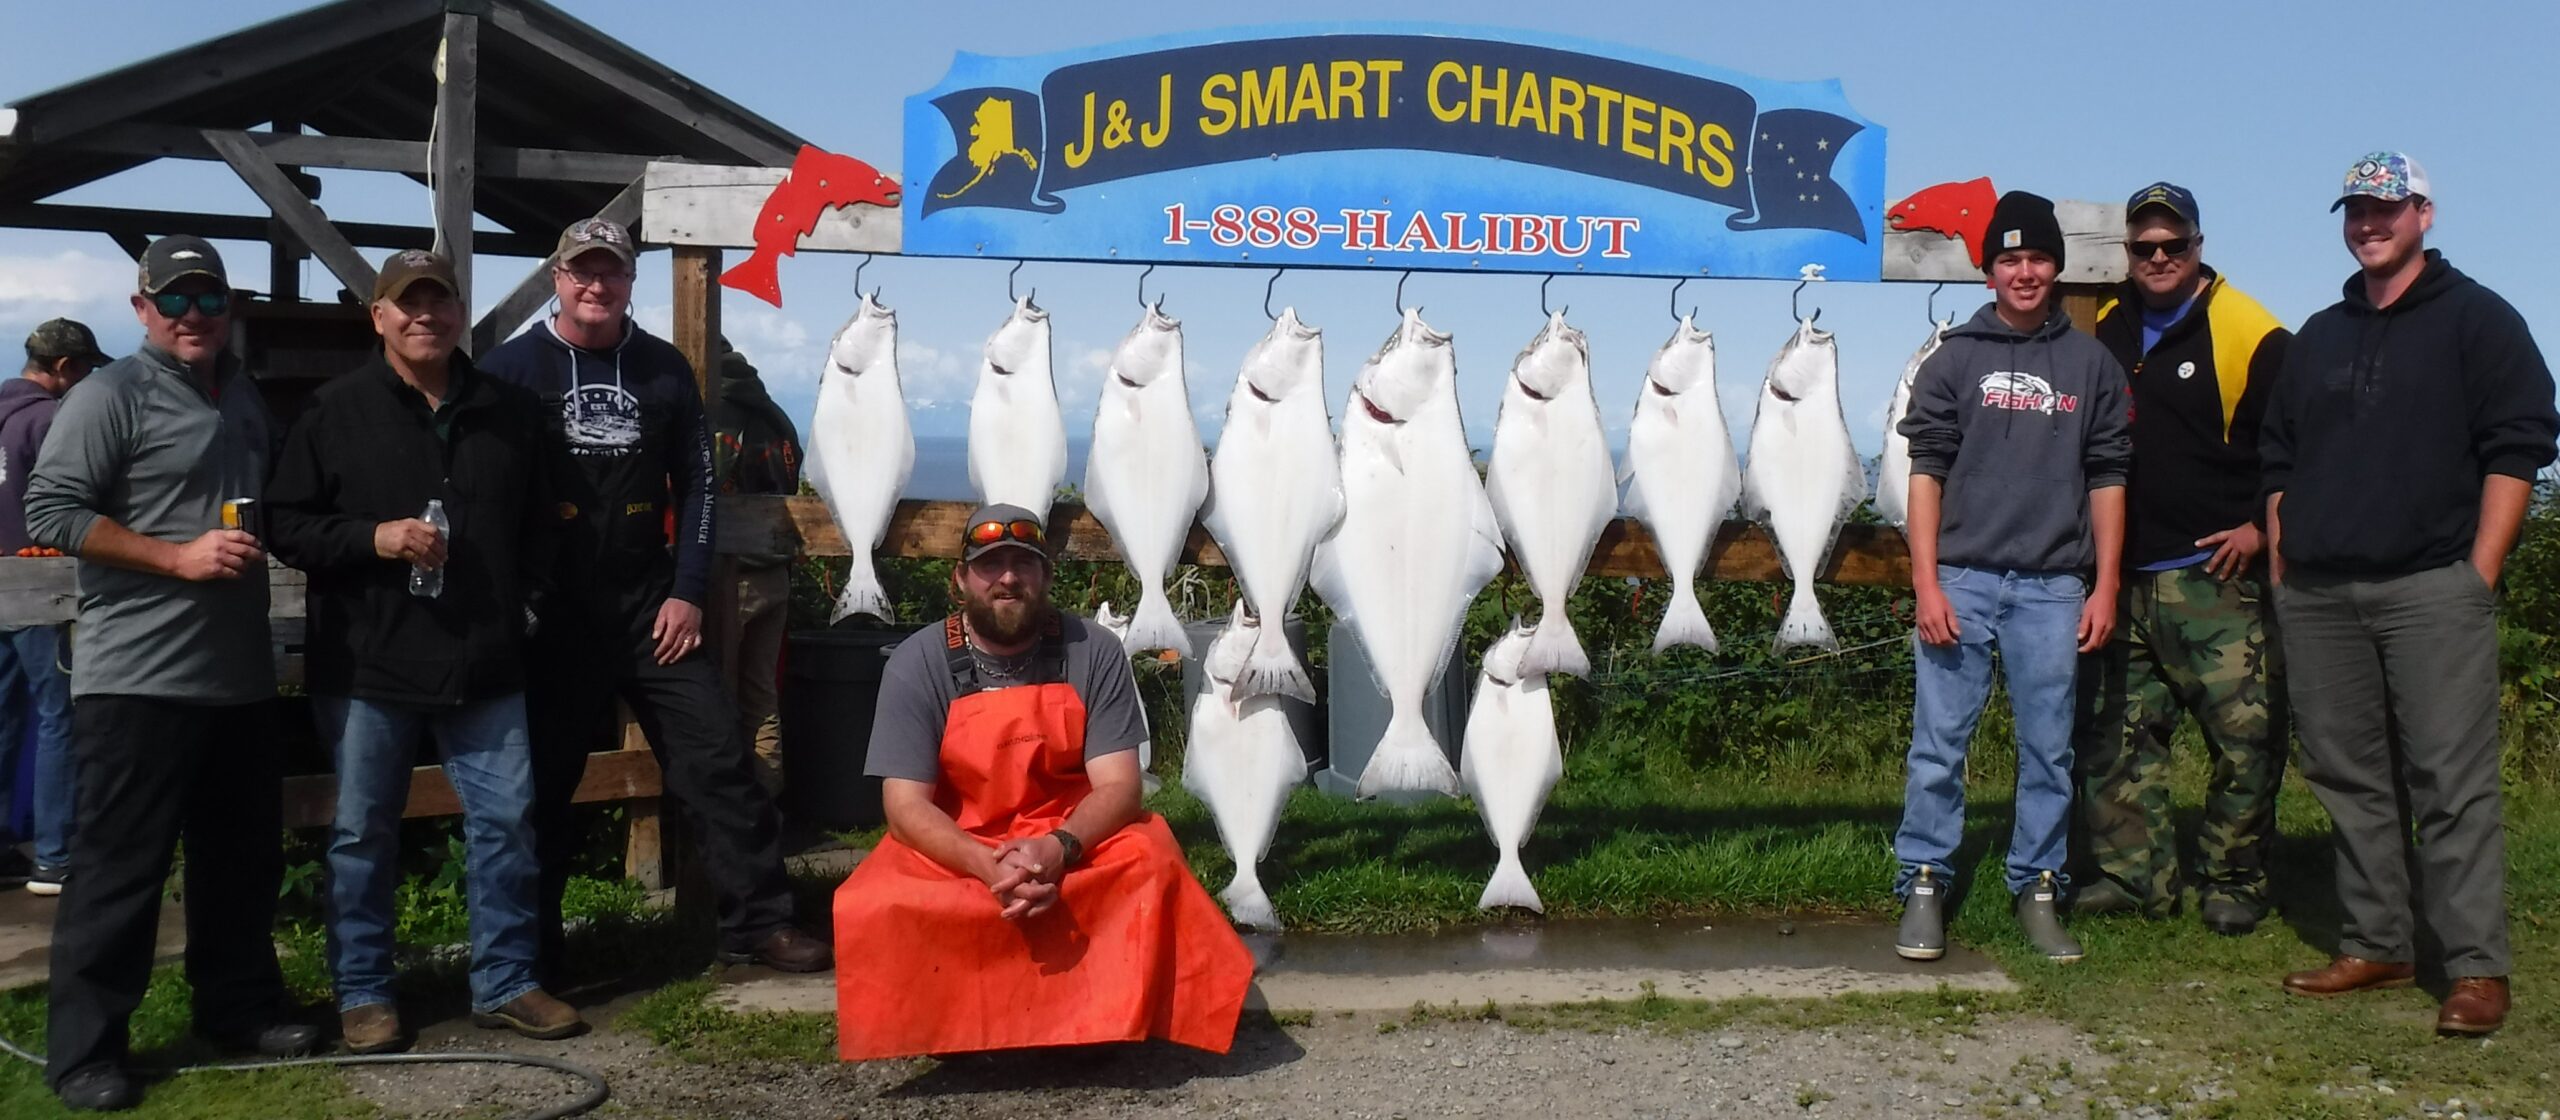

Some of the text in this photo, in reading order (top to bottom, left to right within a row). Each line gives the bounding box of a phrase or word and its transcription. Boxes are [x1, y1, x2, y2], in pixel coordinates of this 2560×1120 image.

[1064, 60, 1735, 188] J&J SMART CHARTERS
[1164, 203, 1640, 259] 1-888-HALIBUT
[697, 493, 714, 544] MISSOURI
